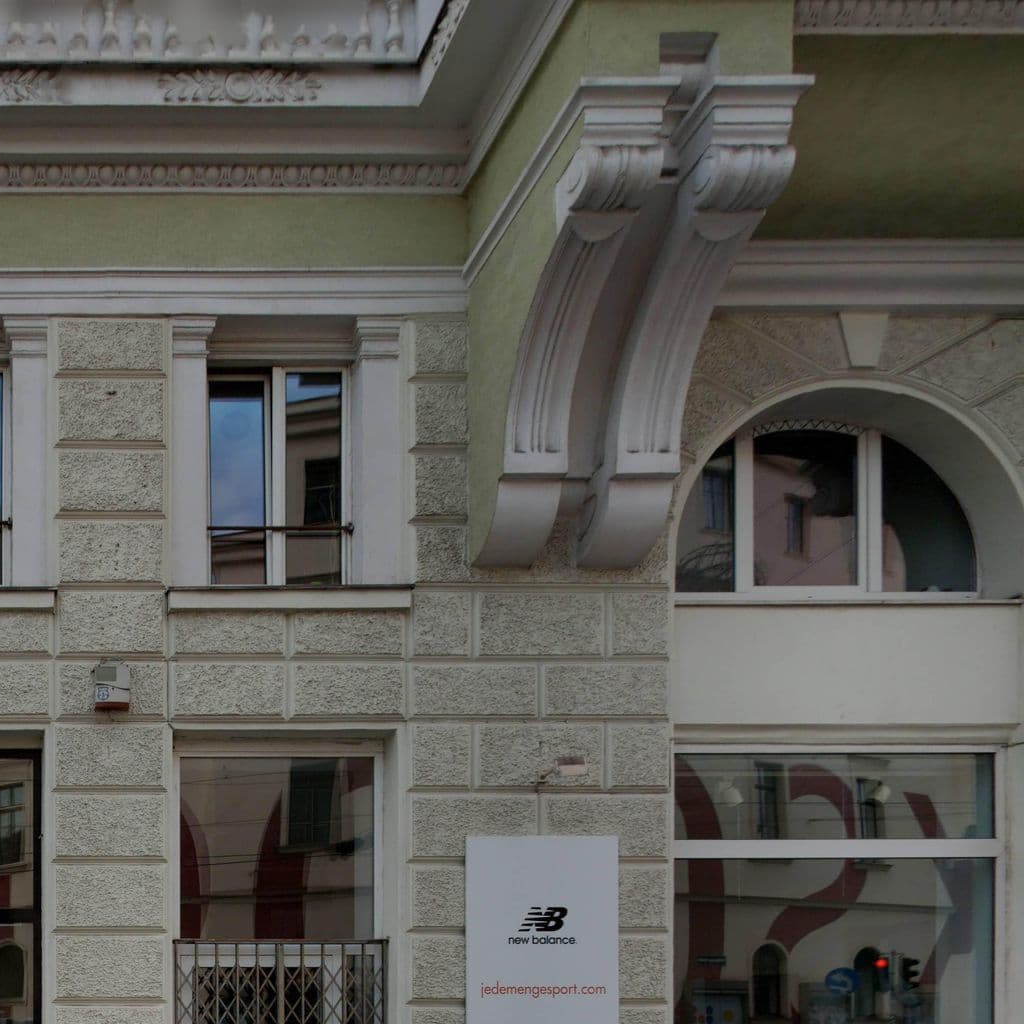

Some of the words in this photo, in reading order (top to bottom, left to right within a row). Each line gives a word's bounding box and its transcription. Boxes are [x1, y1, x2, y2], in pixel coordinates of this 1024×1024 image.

[508, 936, 529, 945] new
[532, 935, 576, 945] balance
[480, 981, 607, 999] jedemengesport.com
